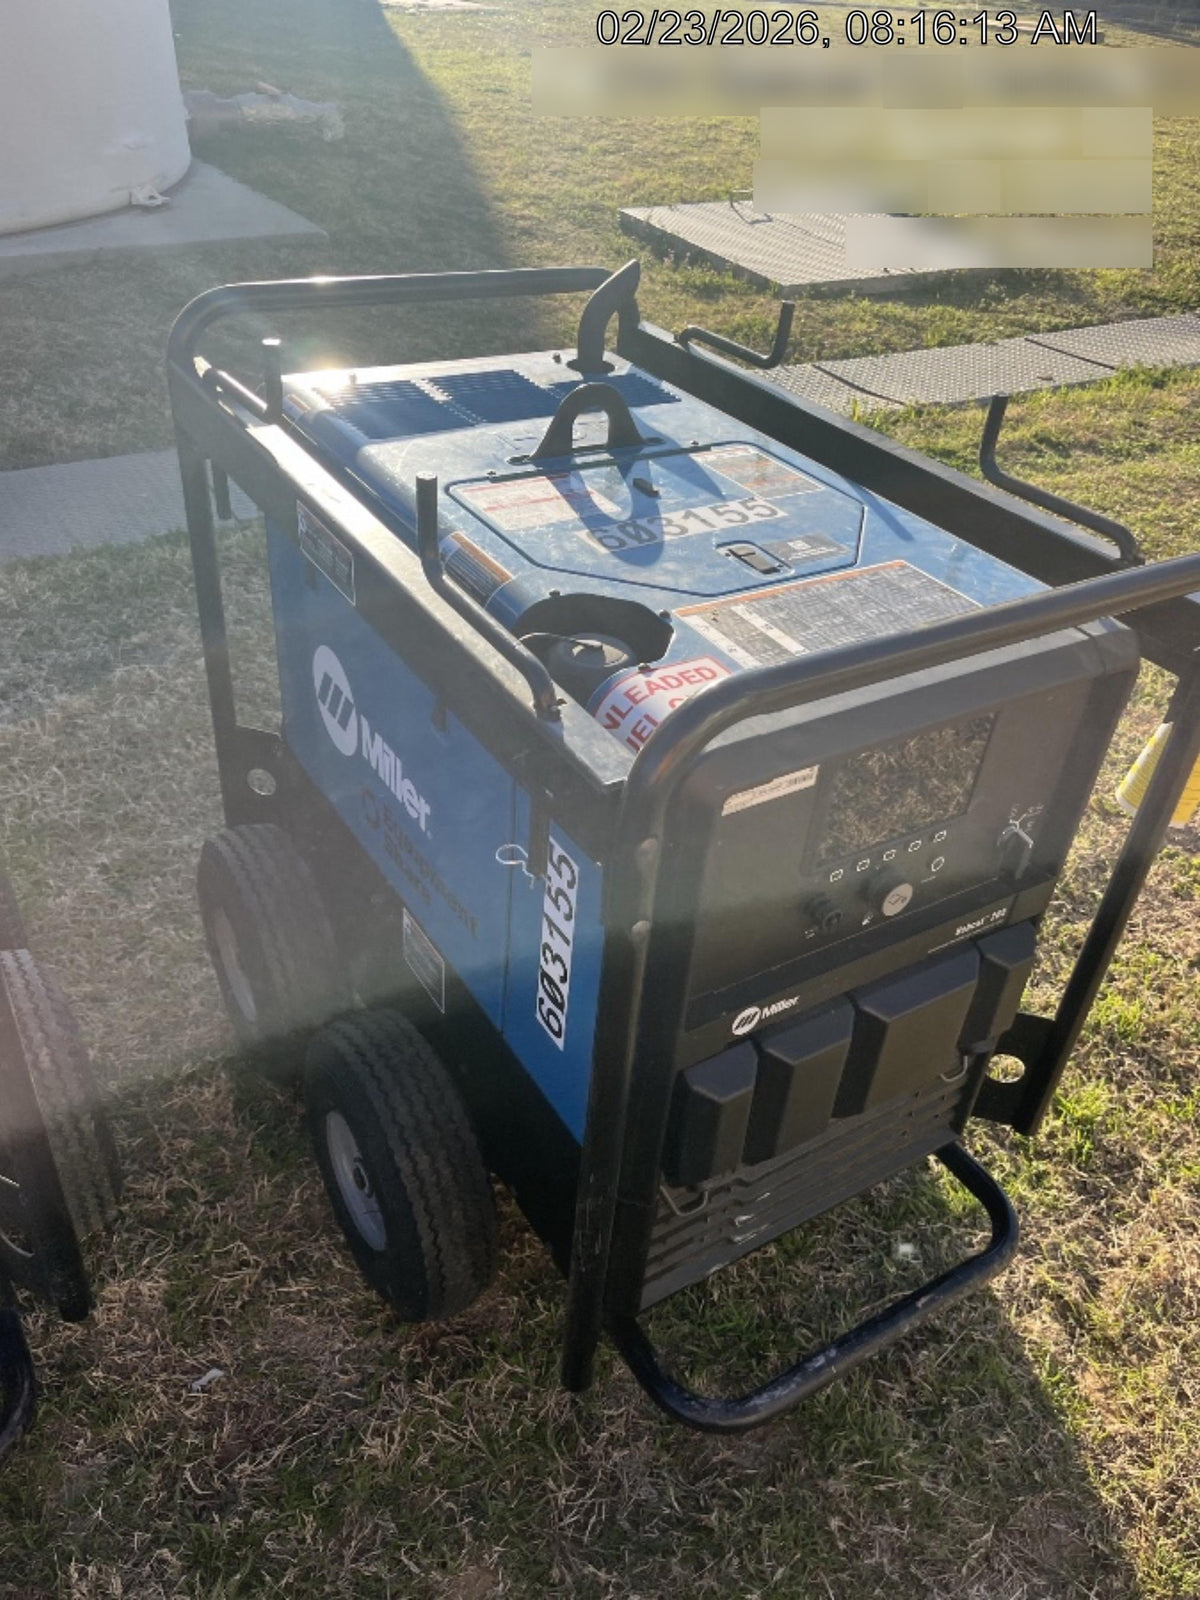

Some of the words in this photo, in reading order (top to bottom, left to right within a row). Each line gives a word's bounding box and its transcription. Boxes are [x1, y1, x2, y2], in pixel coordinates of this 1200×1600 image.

[596, 497, 779, 552] 603155
[602, 666, 718, 731] NLEADED
[360, 713, 431, 833] Miller
[537, 844, 578, 1040] 603155
[761, 994, 801, 1020] Miller
